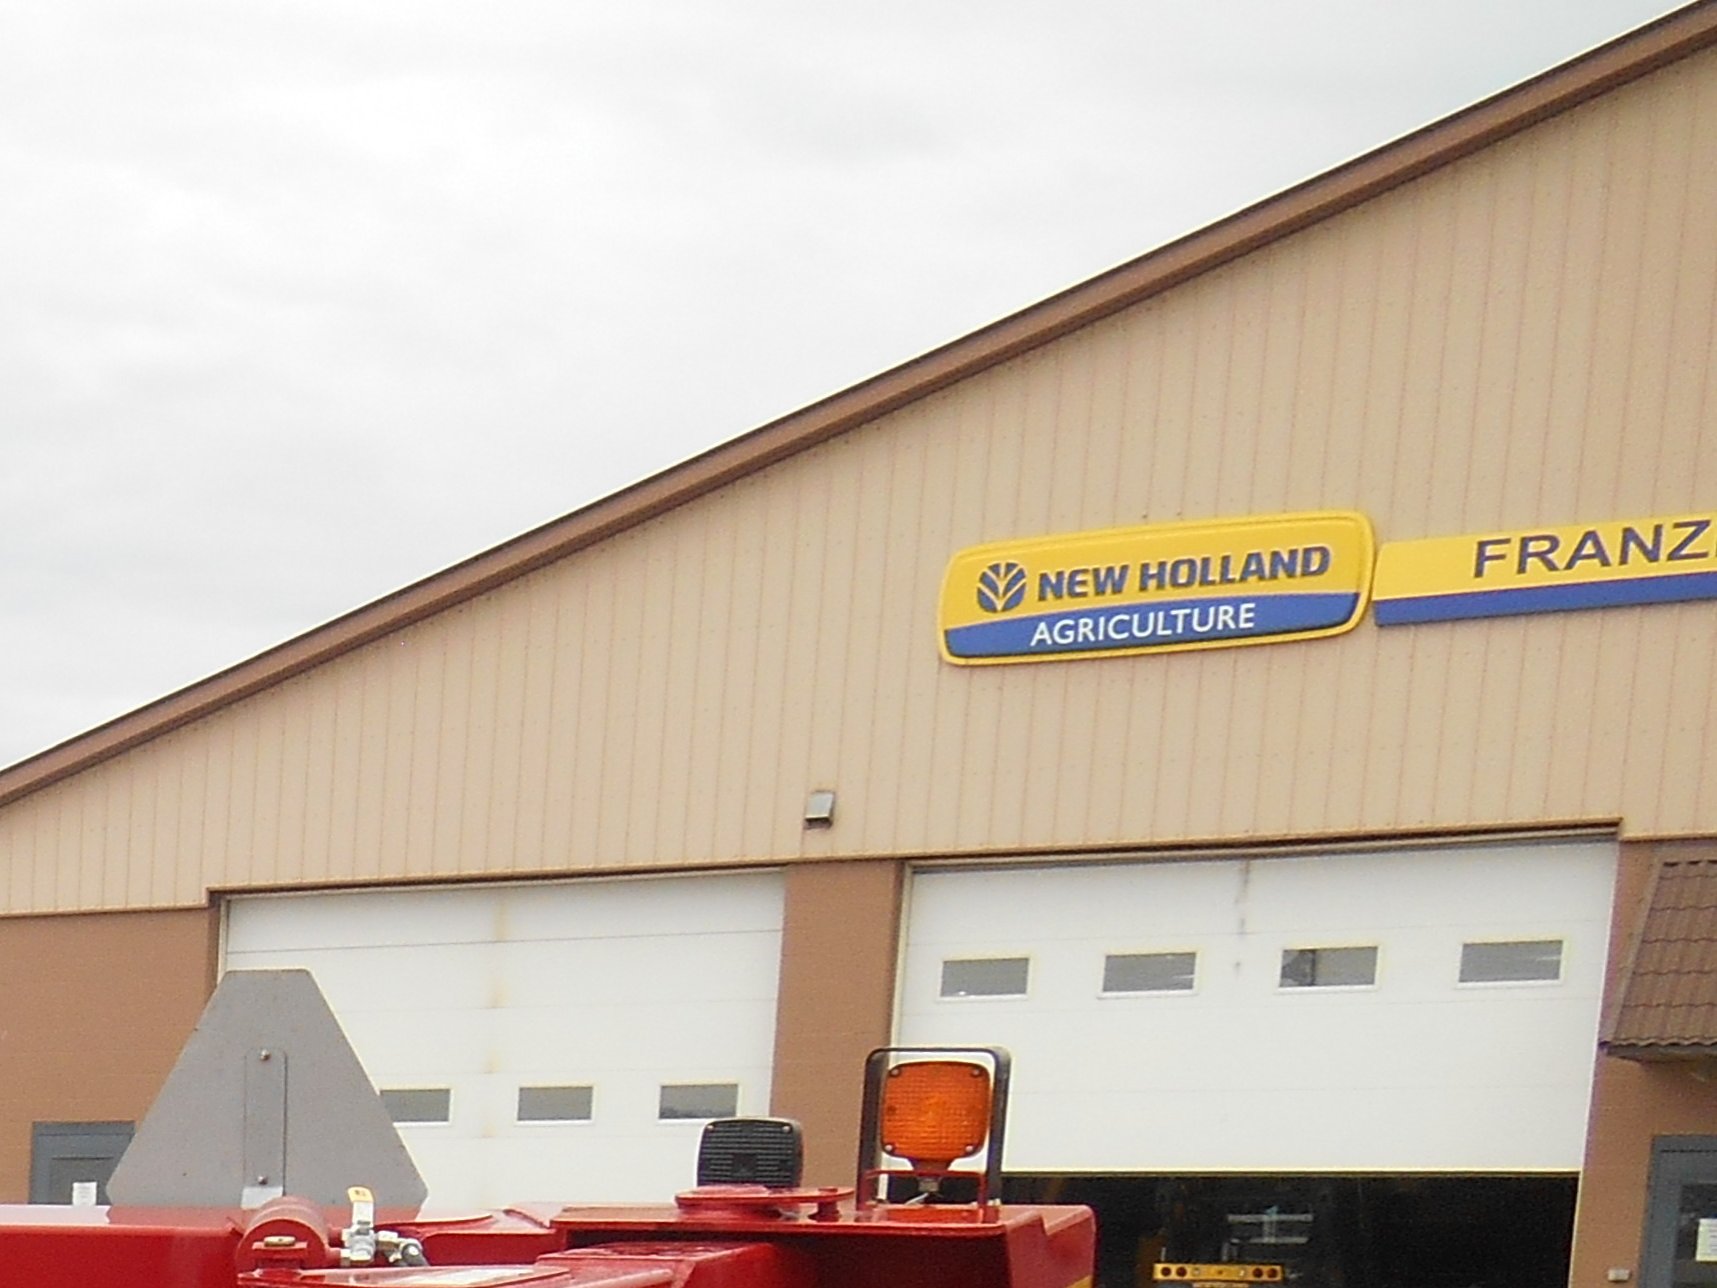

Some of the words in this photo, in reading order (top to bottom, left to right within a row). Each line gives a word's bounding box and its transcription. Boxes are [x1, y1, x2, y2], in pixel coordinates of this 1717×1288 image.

[1038, 565, 1128, 602] NEW
[1138, 545, 1332, 592] HOLLAND
[1473, 519, 1712, 579] FRANZ
[1030, 602, 1256, 647] AGRICULTURE
